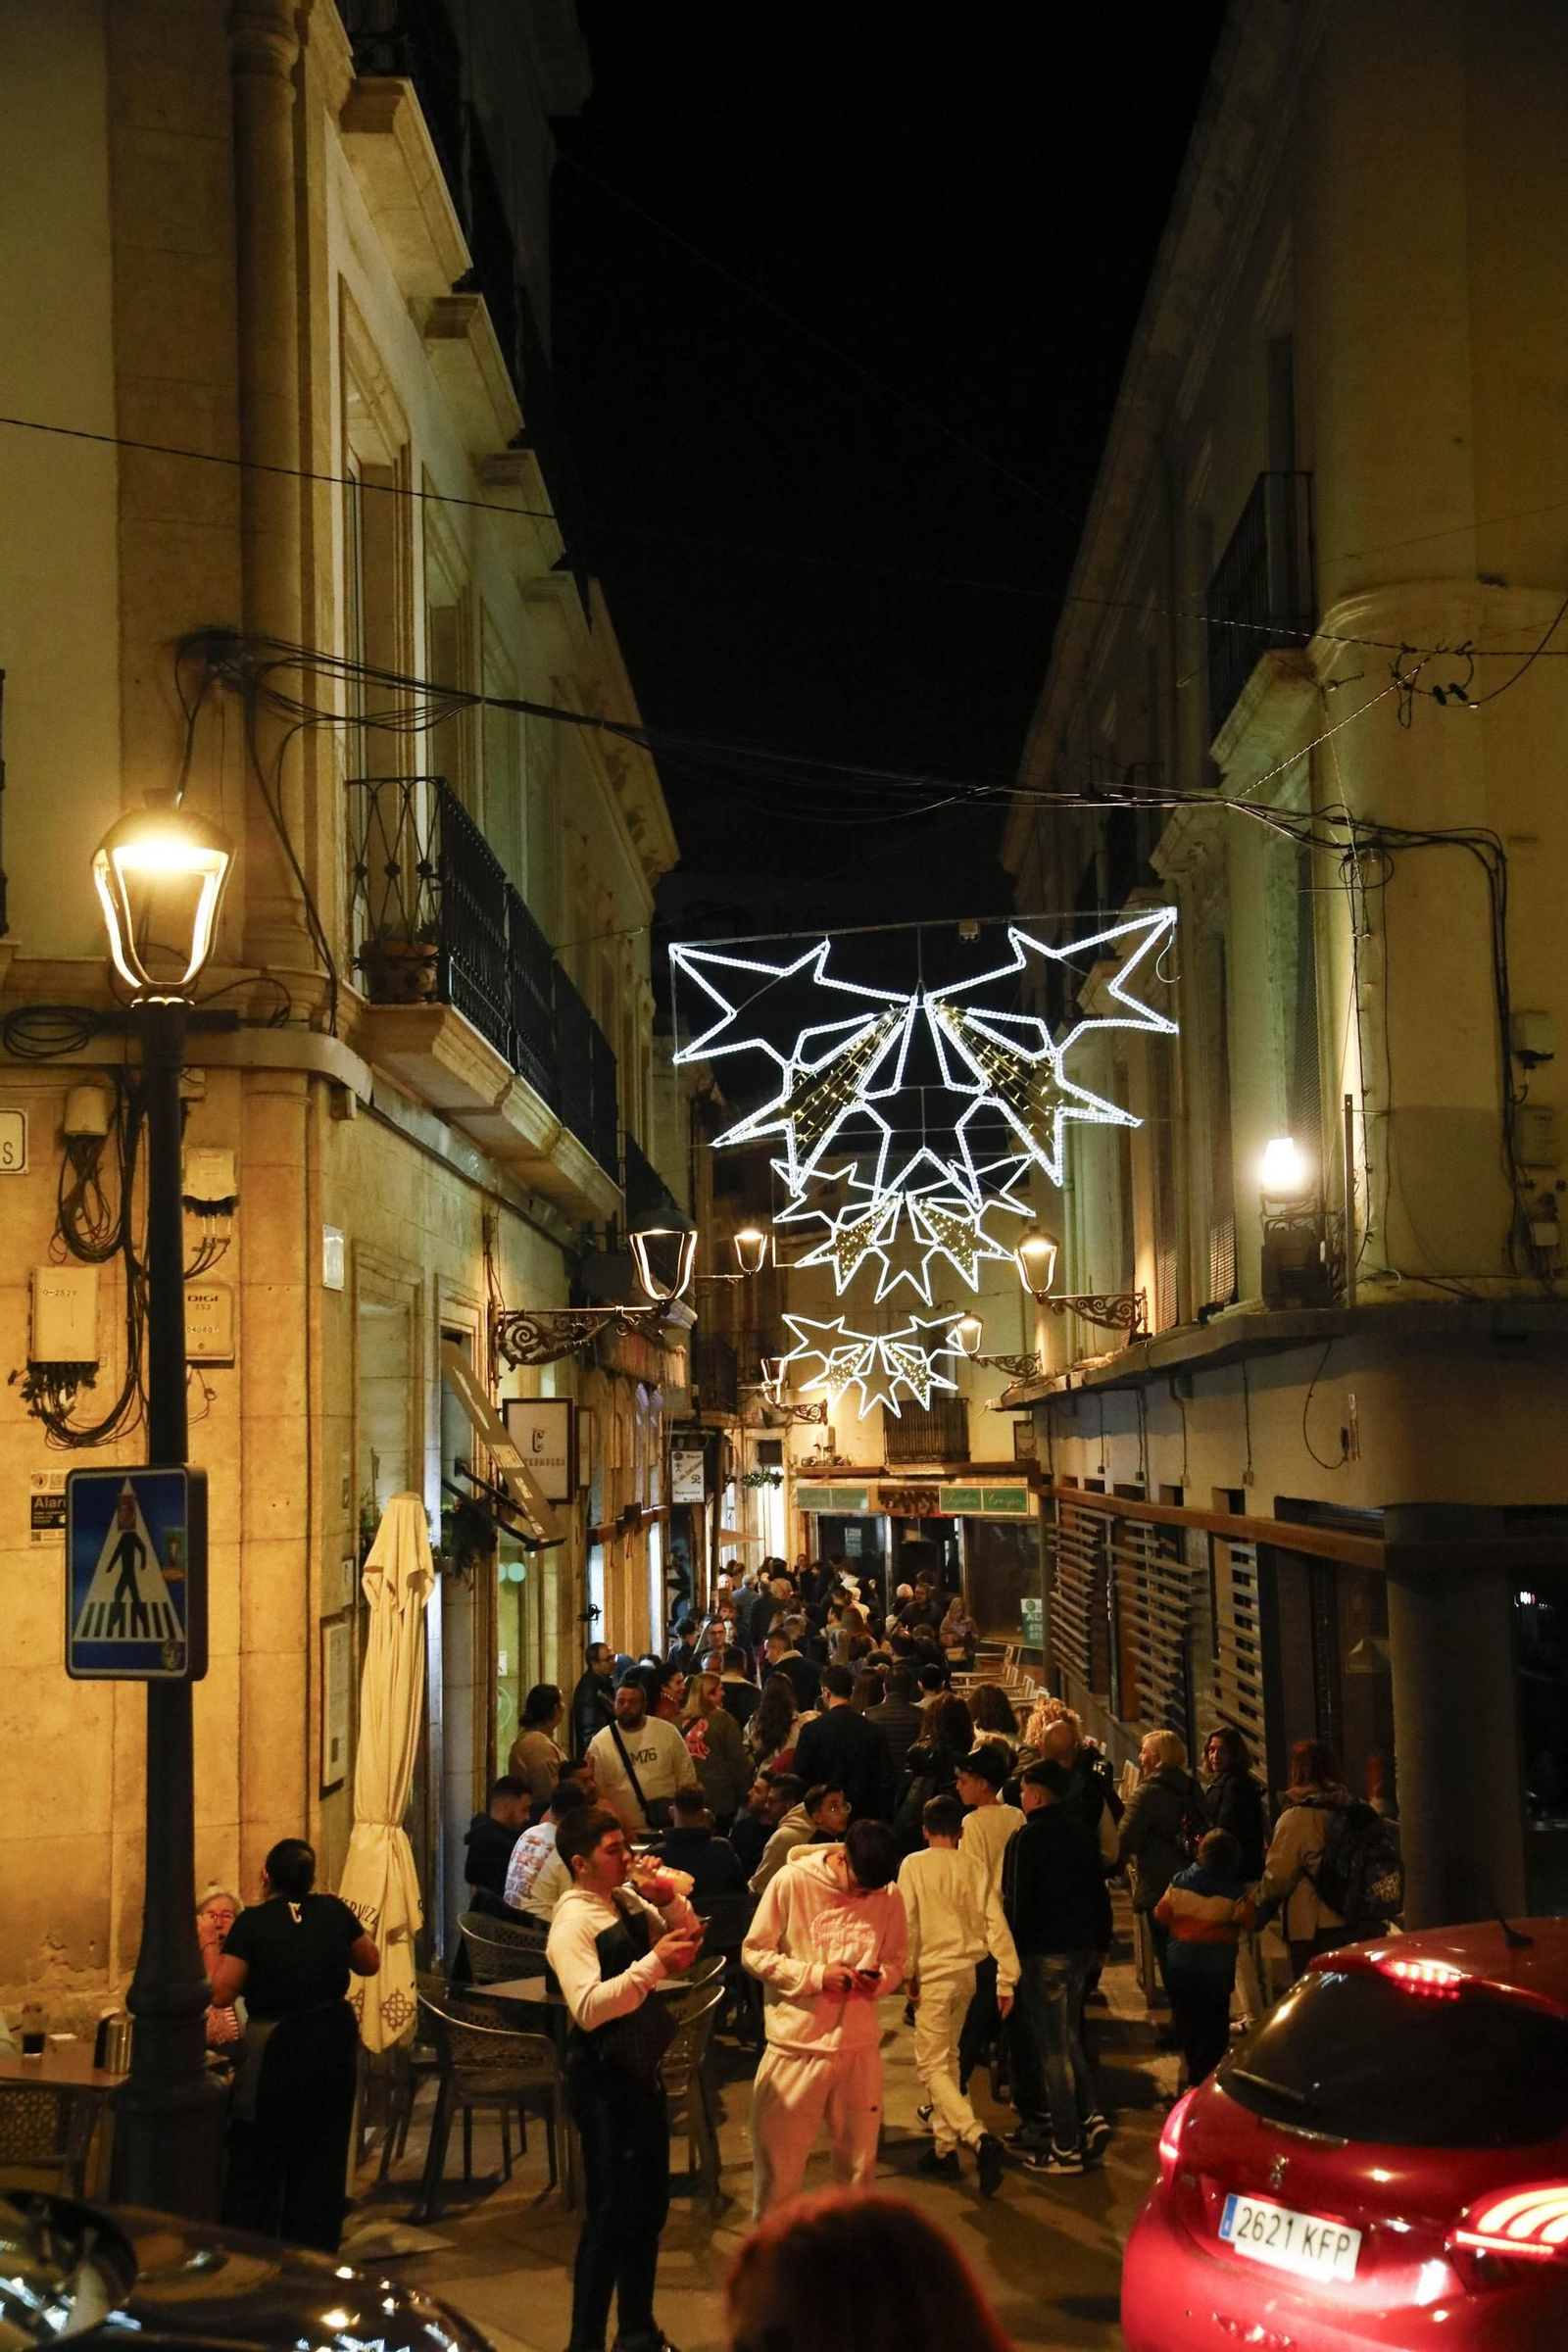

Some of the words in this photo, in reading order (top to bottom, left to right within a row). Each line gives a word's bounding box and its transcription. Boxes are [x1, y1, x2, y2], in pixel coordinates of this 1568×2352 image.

[34, 1496, 66, 1508] Alar
[1237, 2206, 1294, 2249] 2621
[1302, 2223, 1350, 2265] KFP
